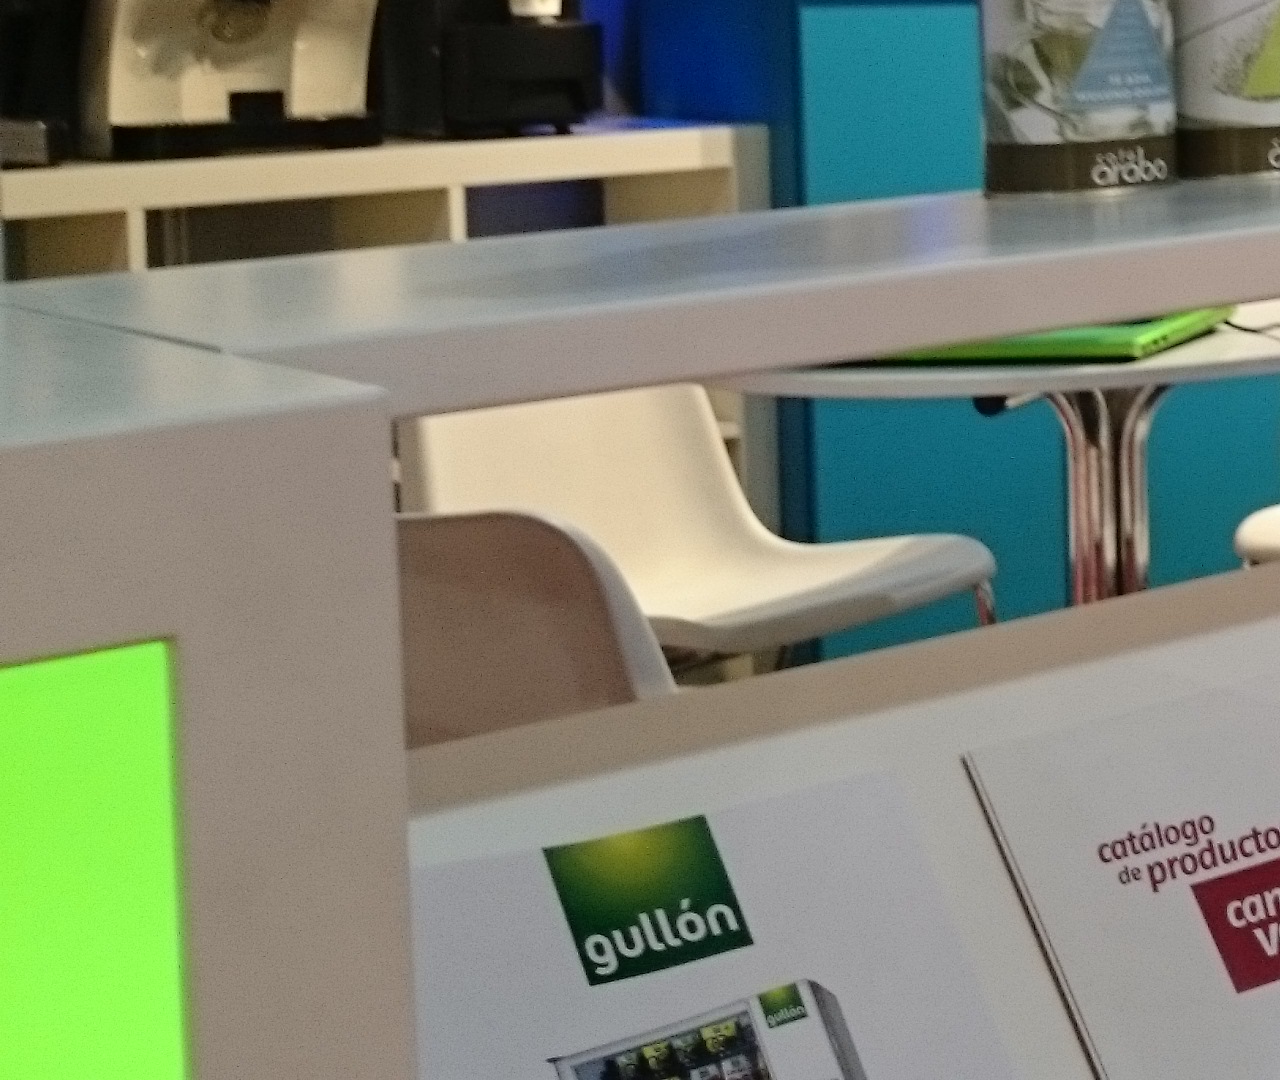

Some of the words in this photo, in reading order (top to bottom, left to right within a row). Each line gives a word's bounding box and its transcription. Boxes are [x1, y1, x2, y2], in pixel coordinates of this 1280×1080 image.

[1090, 145, 1168, 186] arabo
[1097, 814, 1216, 864] catálogo
[1117, 864, 1142, 886] de
[584, 896, 740, 976] gullón
